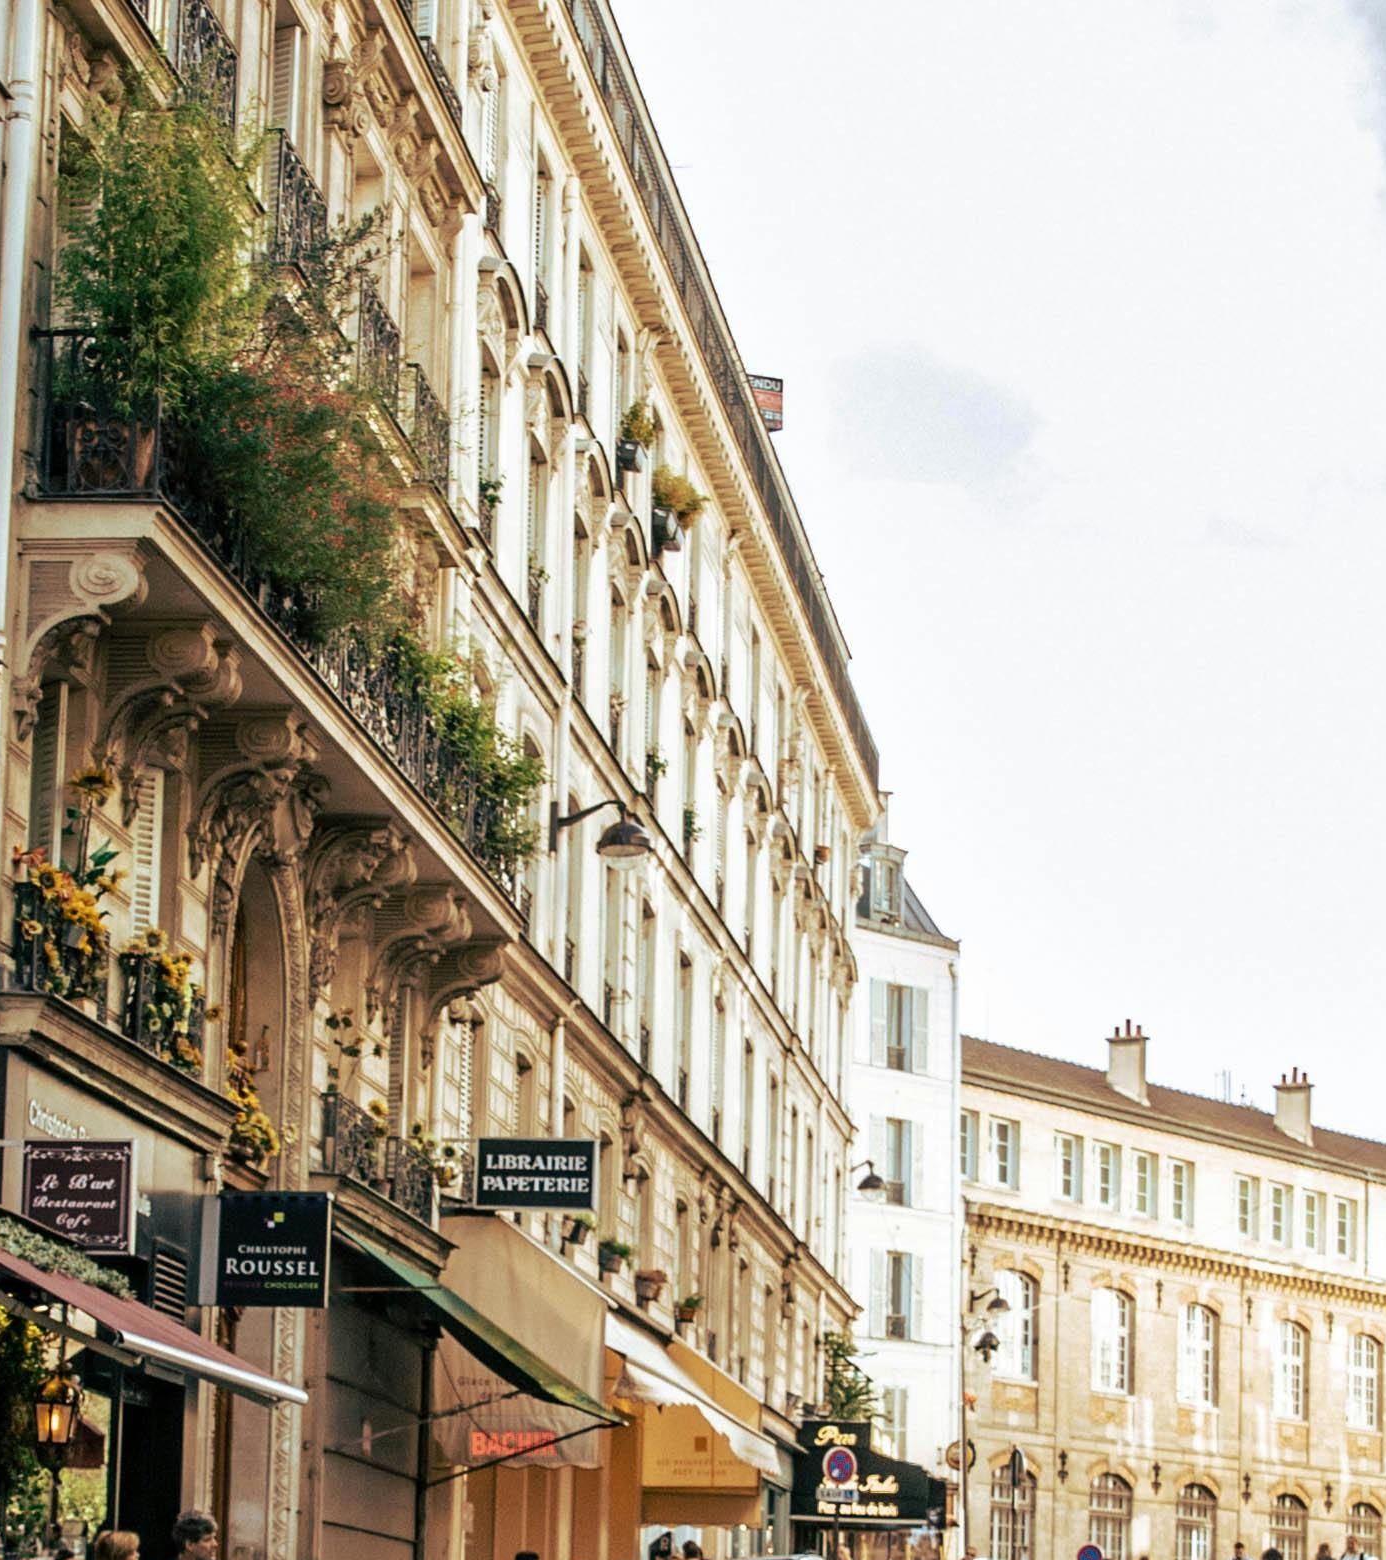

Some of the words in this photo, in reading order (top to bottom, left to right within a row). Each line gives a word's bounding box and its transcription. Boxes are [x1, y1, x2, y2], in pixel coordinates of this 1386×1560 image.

[485, 1153, 588, 1171] LIBRAIRIE
[35, 1173, 60, 1192] Le
[481, 1175, 590, 1193] PAPETERIE
[31, 1196, 117, 1209] Restaurant
[225, 1257, 320, 1276] ROUSSEL
